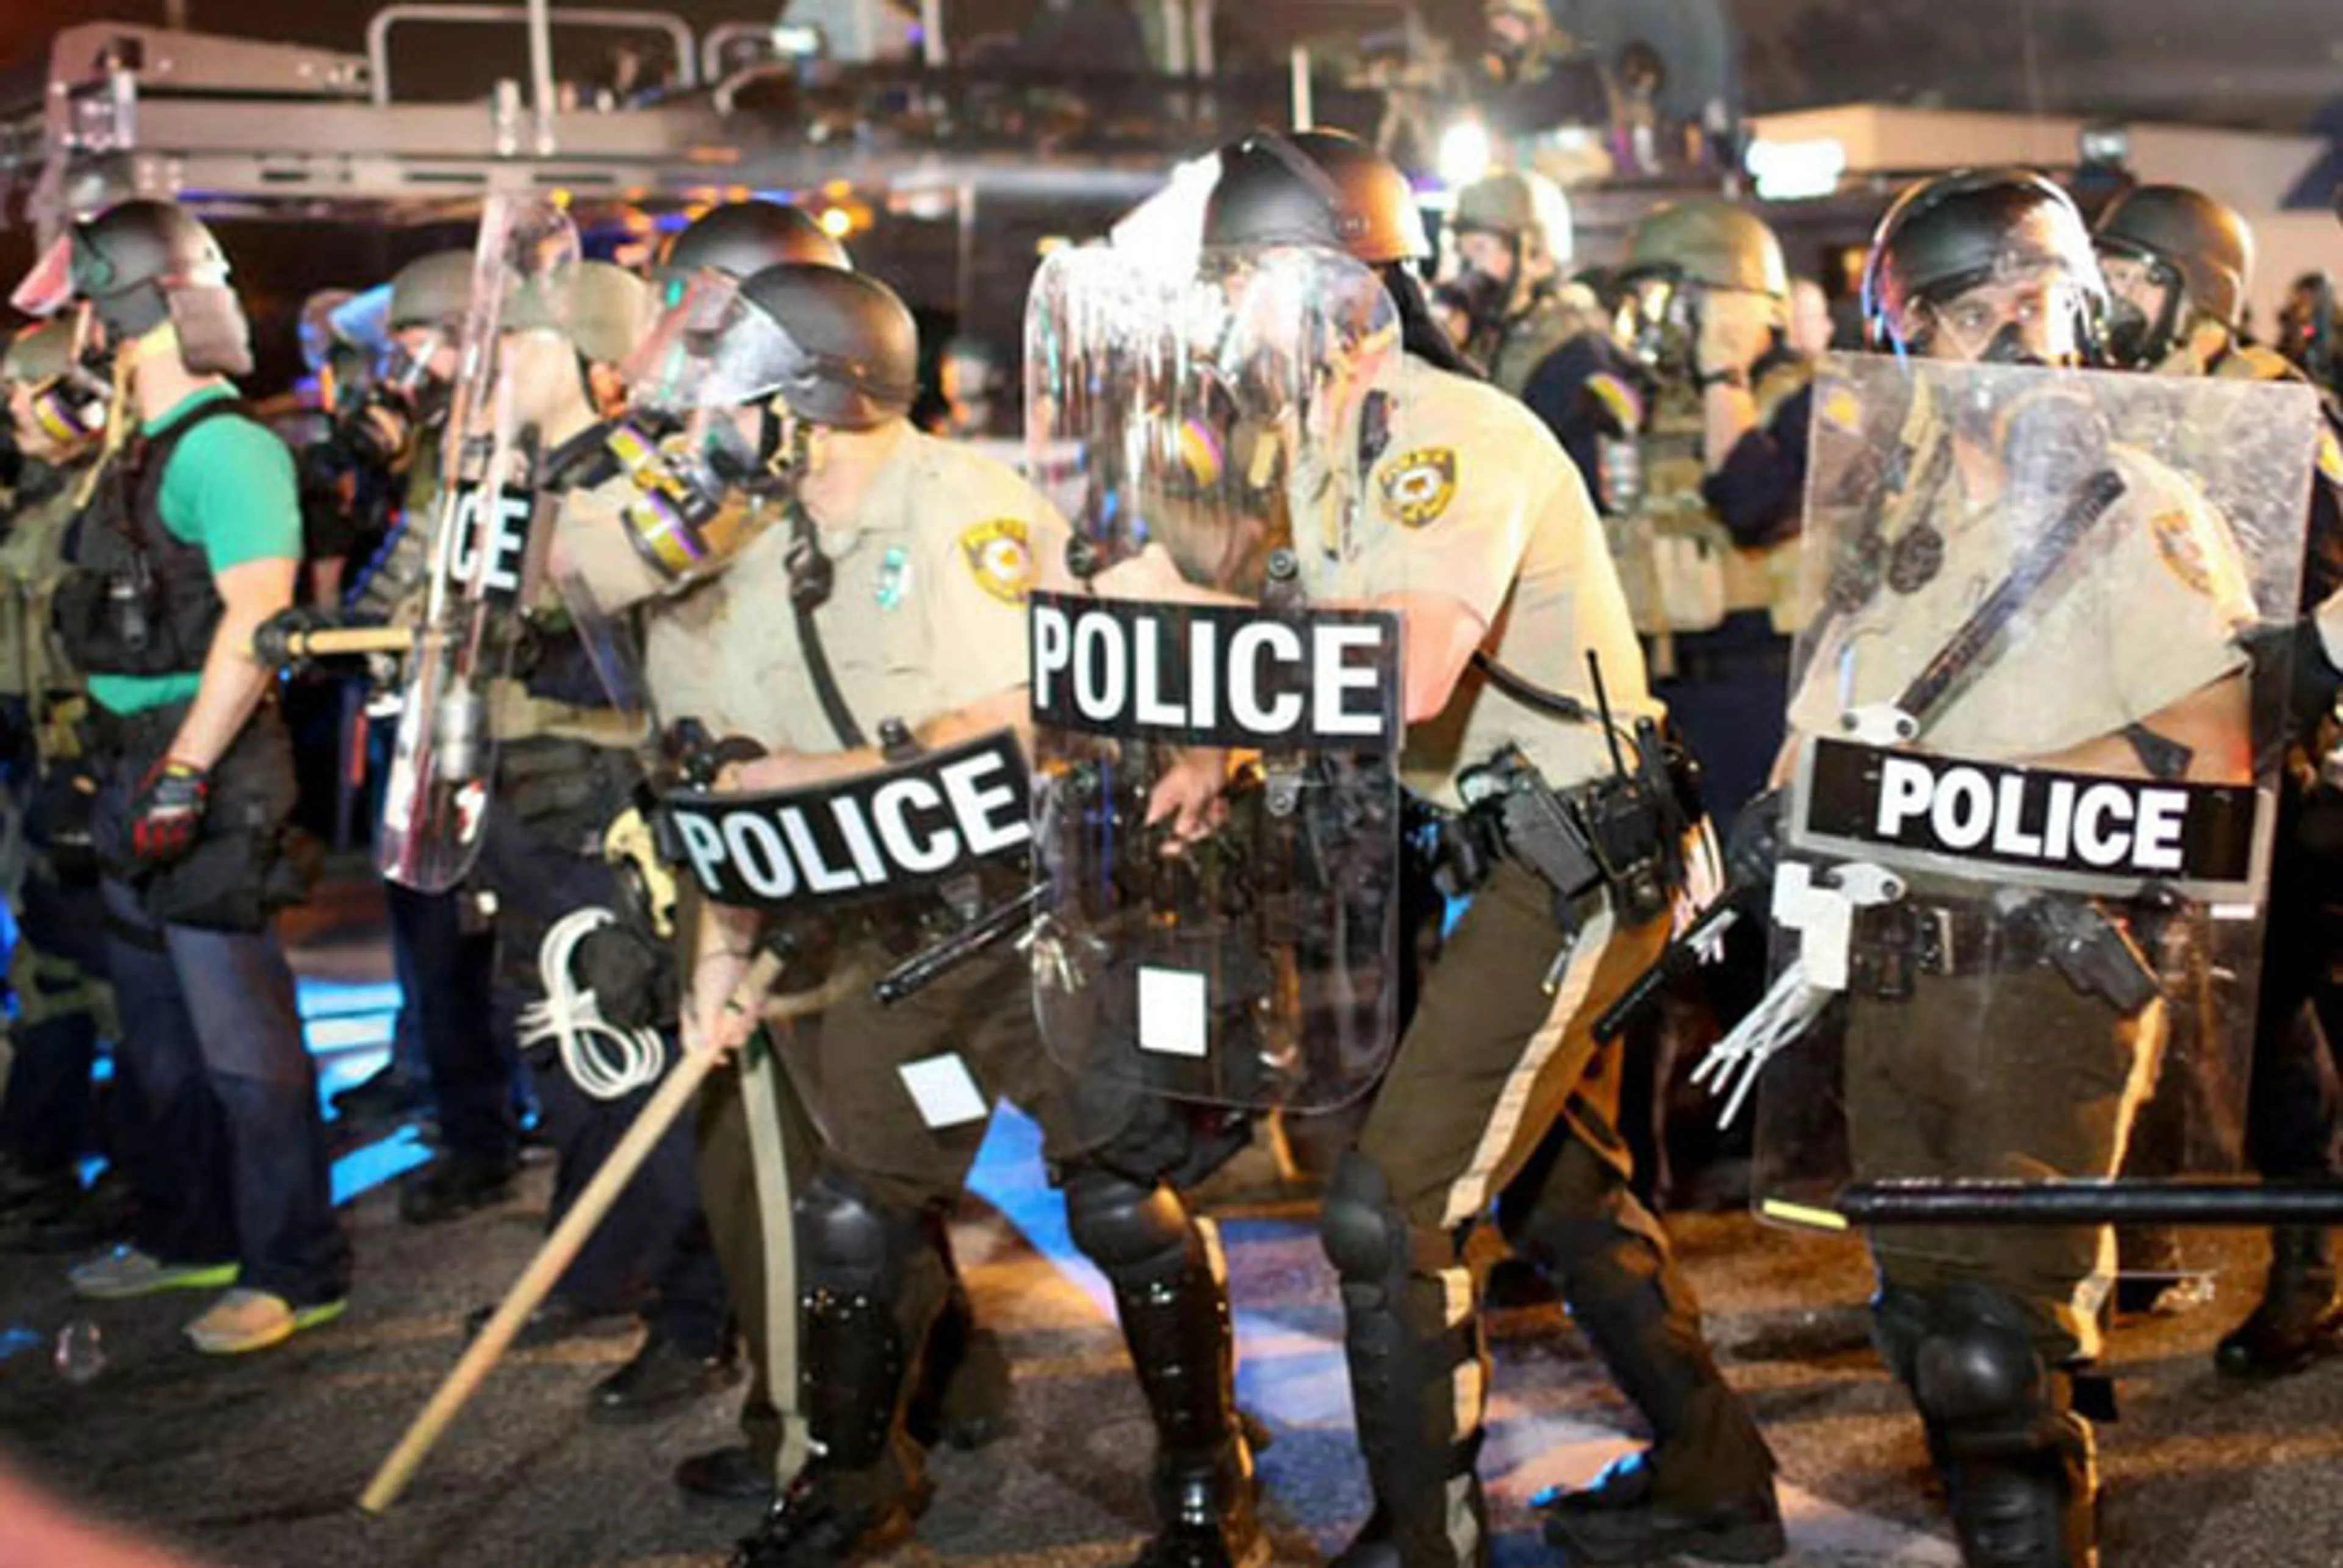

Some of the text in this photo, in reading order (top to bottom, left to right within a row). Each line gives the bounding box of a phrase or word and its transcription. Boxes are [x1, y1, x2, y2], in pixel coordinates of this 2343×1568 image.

[1034, 605, 1383, 734] POLICE
[673, 750, 1032, 899] POLICE
[1876, 758, 2189, 870] POLICE
